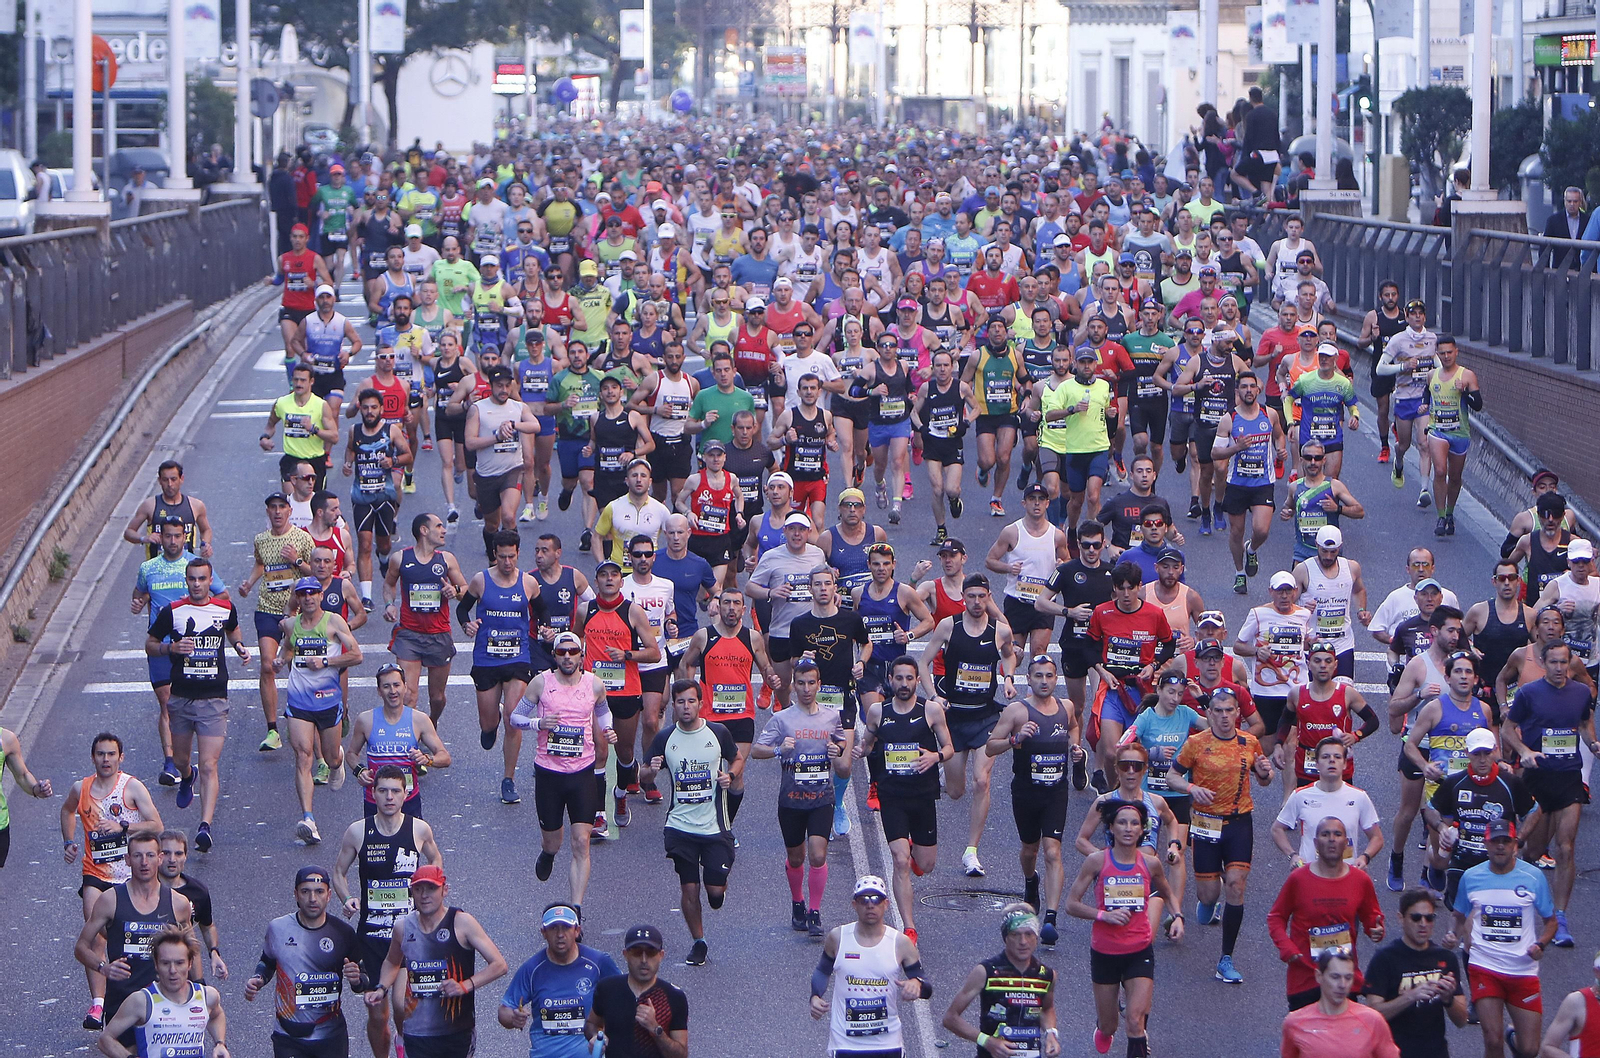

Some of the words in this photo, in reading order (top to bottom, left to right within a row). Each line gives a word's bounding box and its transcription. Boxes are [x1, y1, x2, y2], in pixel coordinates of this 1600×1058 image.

[709, 506, 727, 515] ZURICH
[1027, 577, 1046, 585] ZURICH
[486, 610, 522, 618] TROTASIERRA
[1119, 637, 1139, 645] ZURICH
[795, 729, 829, 740] BERLIN
[1163, 734, 1179, 743] FISIO
[684, 772, 707, 780] ZURICH
[380, 880, 404, 888] ZURICH
[1116, 877, 1140, 885] ZURICH
[380, 892, 396, 900] 1063
[1494, 906, 1519, 914] ZURICH
[1493, 919, 1510, 927] 3155
[1321, 924, 1346, 934] ZURICH
[418, 961, 443, 969] ZURICH
[845, 974, 890, 987] Venezuela
[1005, 992, 1036, 1000] LINCOLN
[553, 998, 579, 1006] ZURICH
[858, 999, 883, 1007] ZURICH
[554, 1012, 572, 1020] 2525
[858, 1012, 876, 1020] 2975
[1013, 1028, 1036, 1036] ZURICH
[176, 1048, 200, 1057] ZURICH
